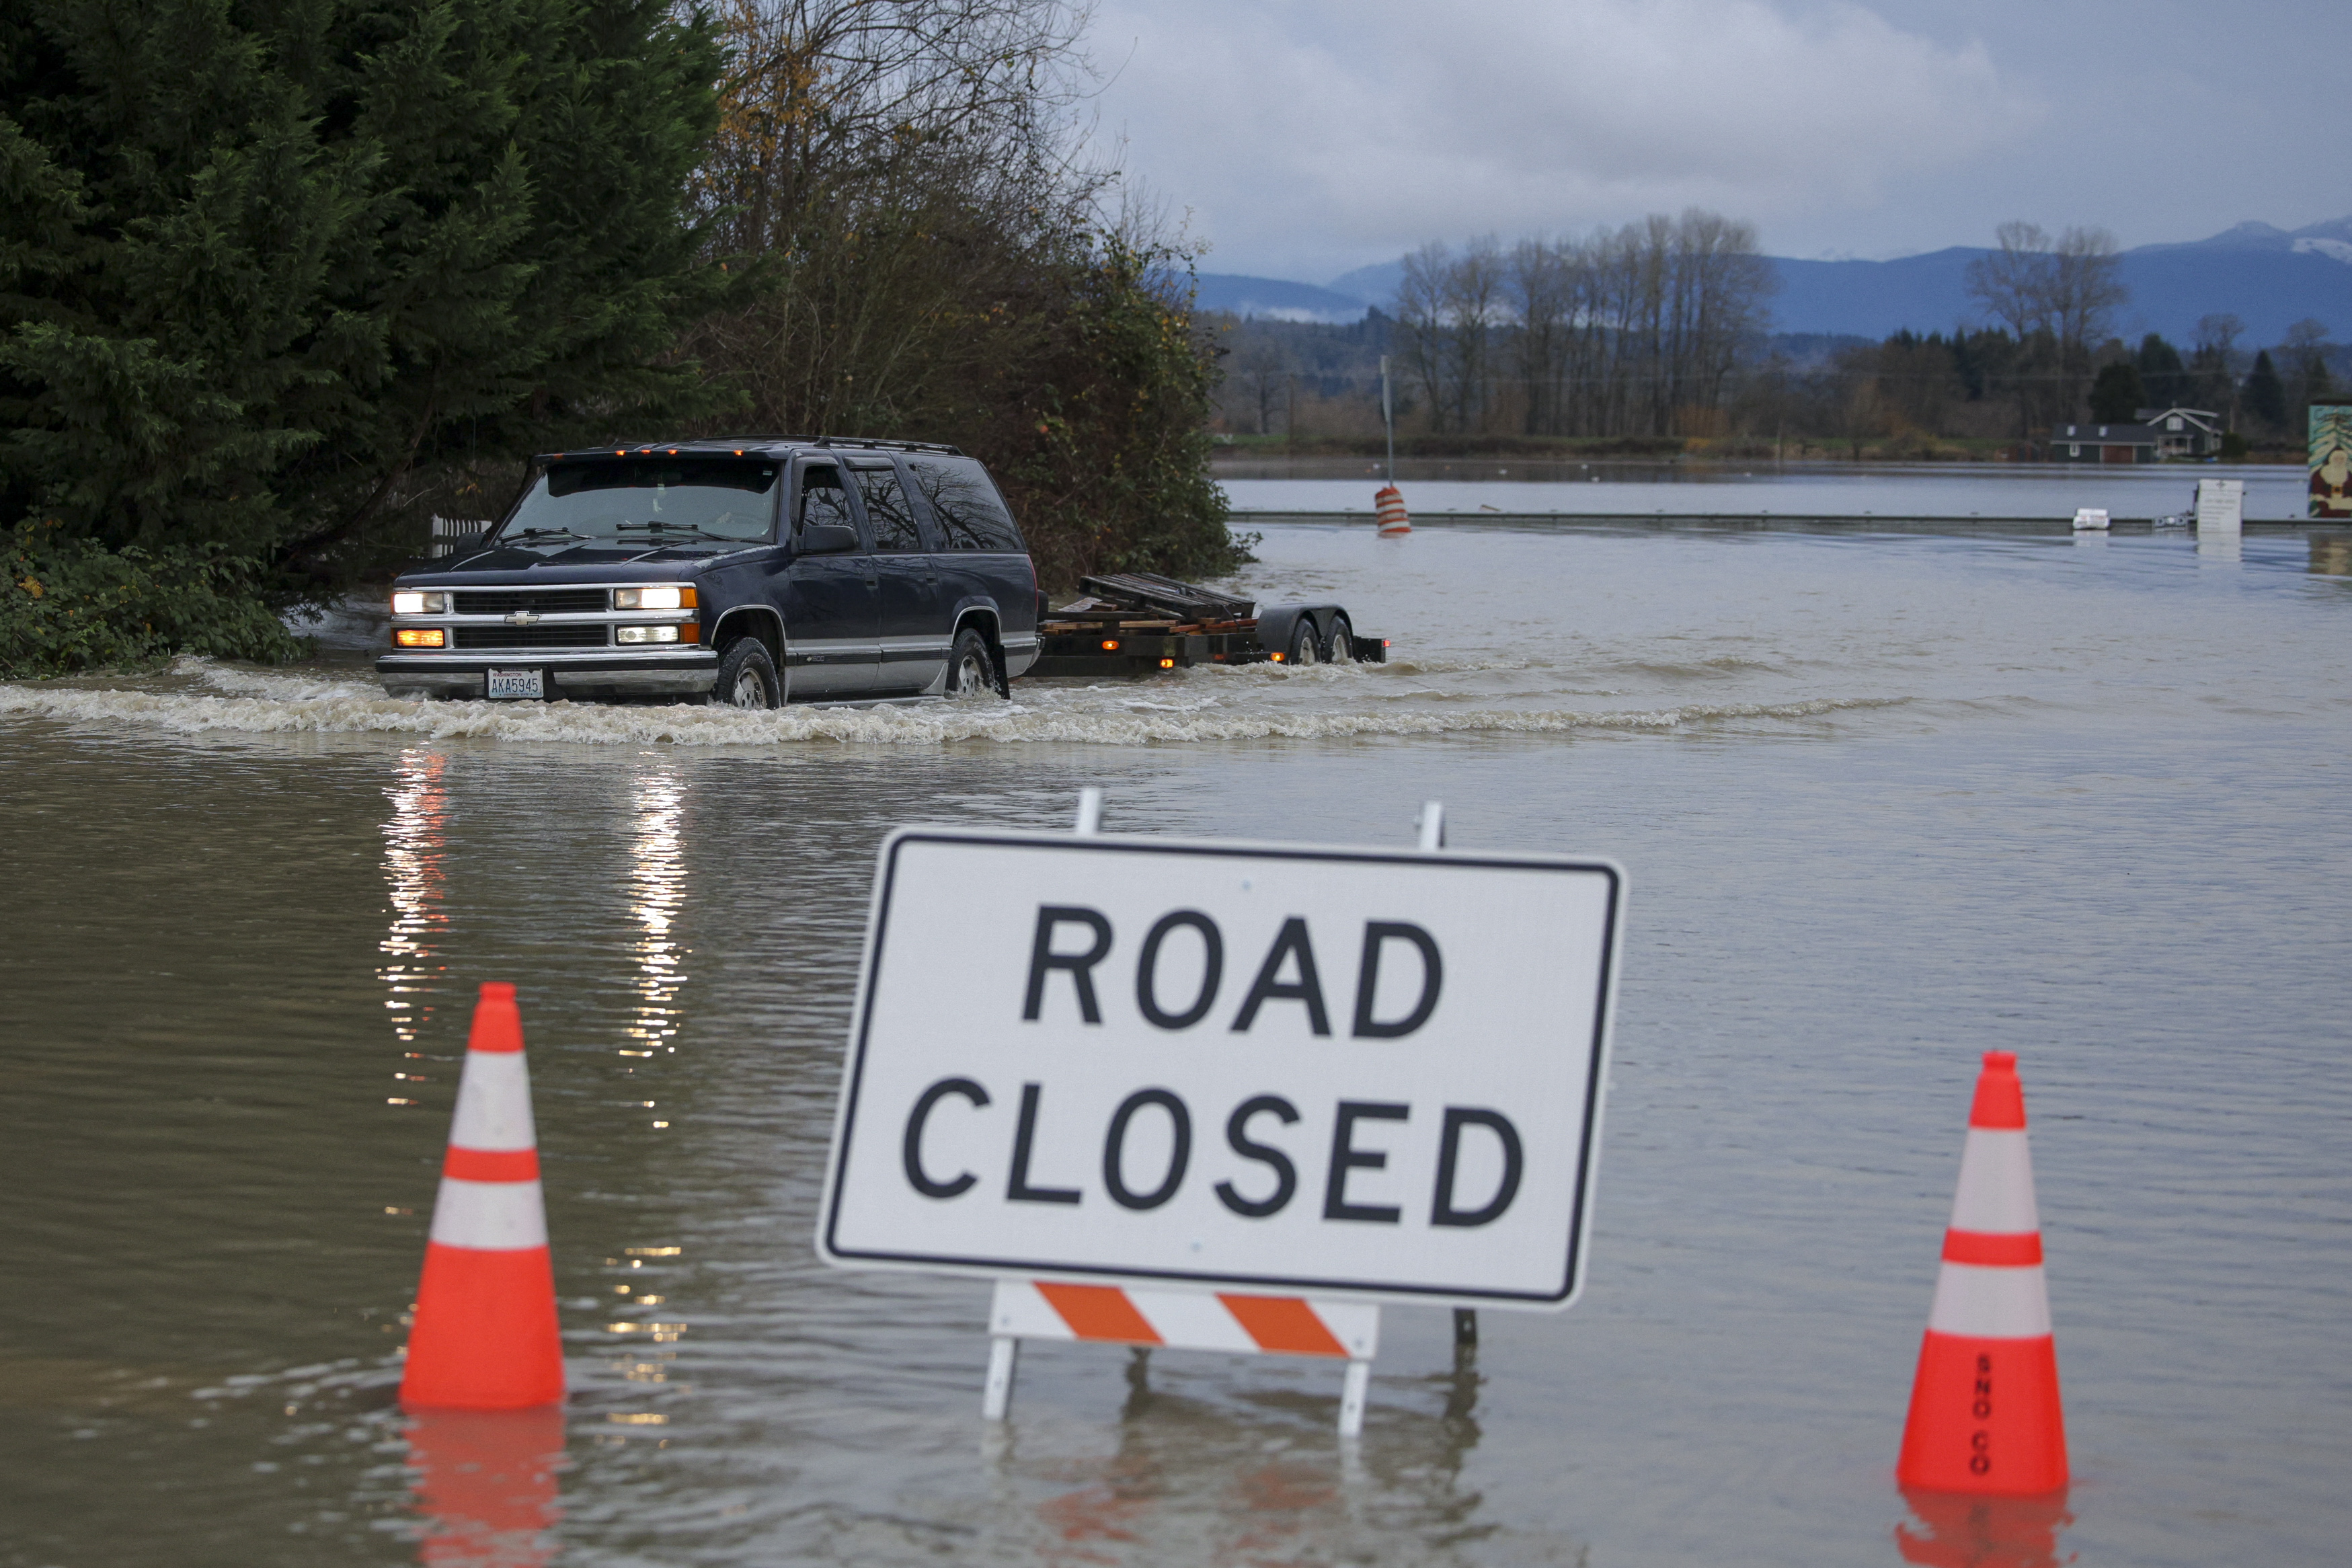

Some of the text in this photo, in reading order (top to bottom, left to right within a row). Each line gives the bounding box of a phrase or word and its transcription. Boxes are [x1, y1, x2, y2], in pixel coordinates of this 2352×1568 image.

[492, 678, 538, 693] AKA5945
[1022, 905, 1443, 1040] ROAD
[903, 1077, 1523, 1228] CLOSED
